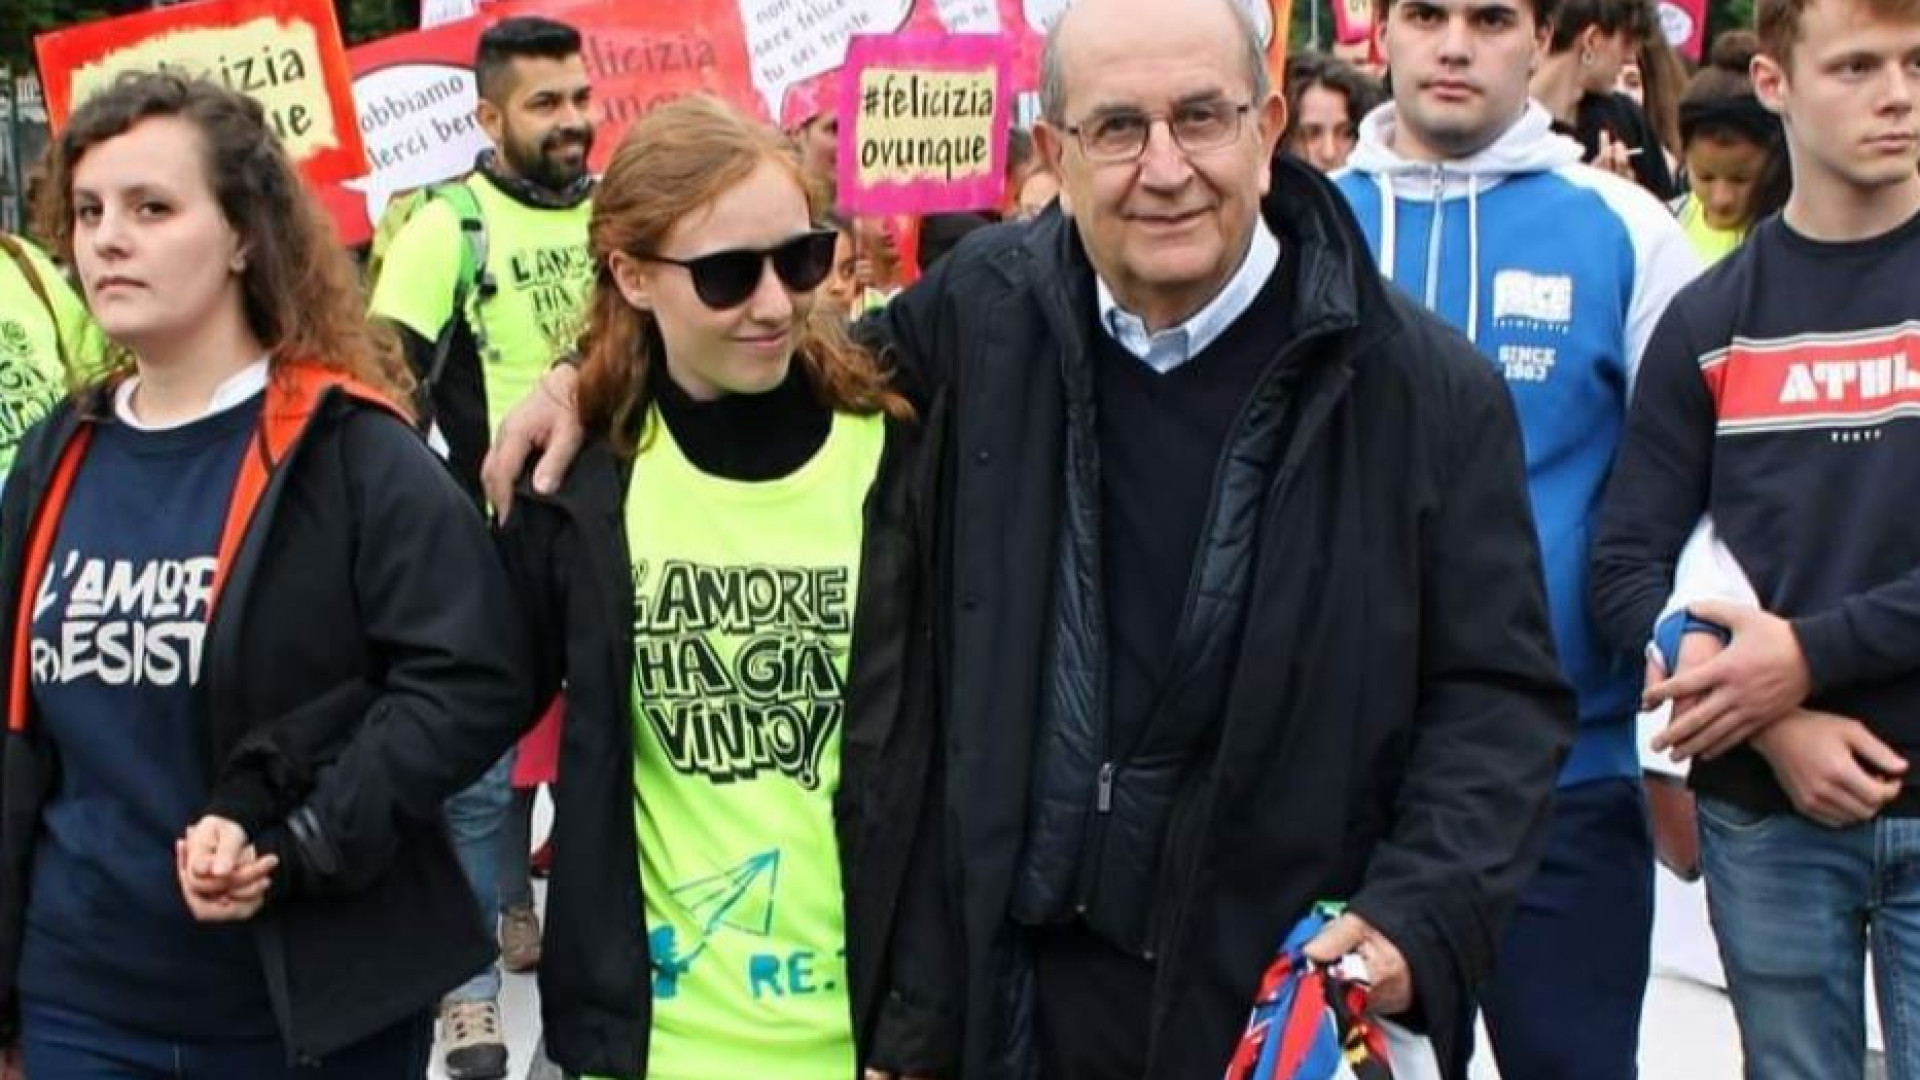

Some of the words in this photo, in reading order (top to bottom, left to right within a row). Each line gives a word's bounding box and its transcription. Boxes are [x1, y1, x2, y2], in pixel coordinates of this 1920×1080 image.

[862, 75, 992, 119] #felicizia
[861, 135, 987, 181] ovunque
[636, 632, 738, 699] HA
[749, 948, 846, 998] RE.
